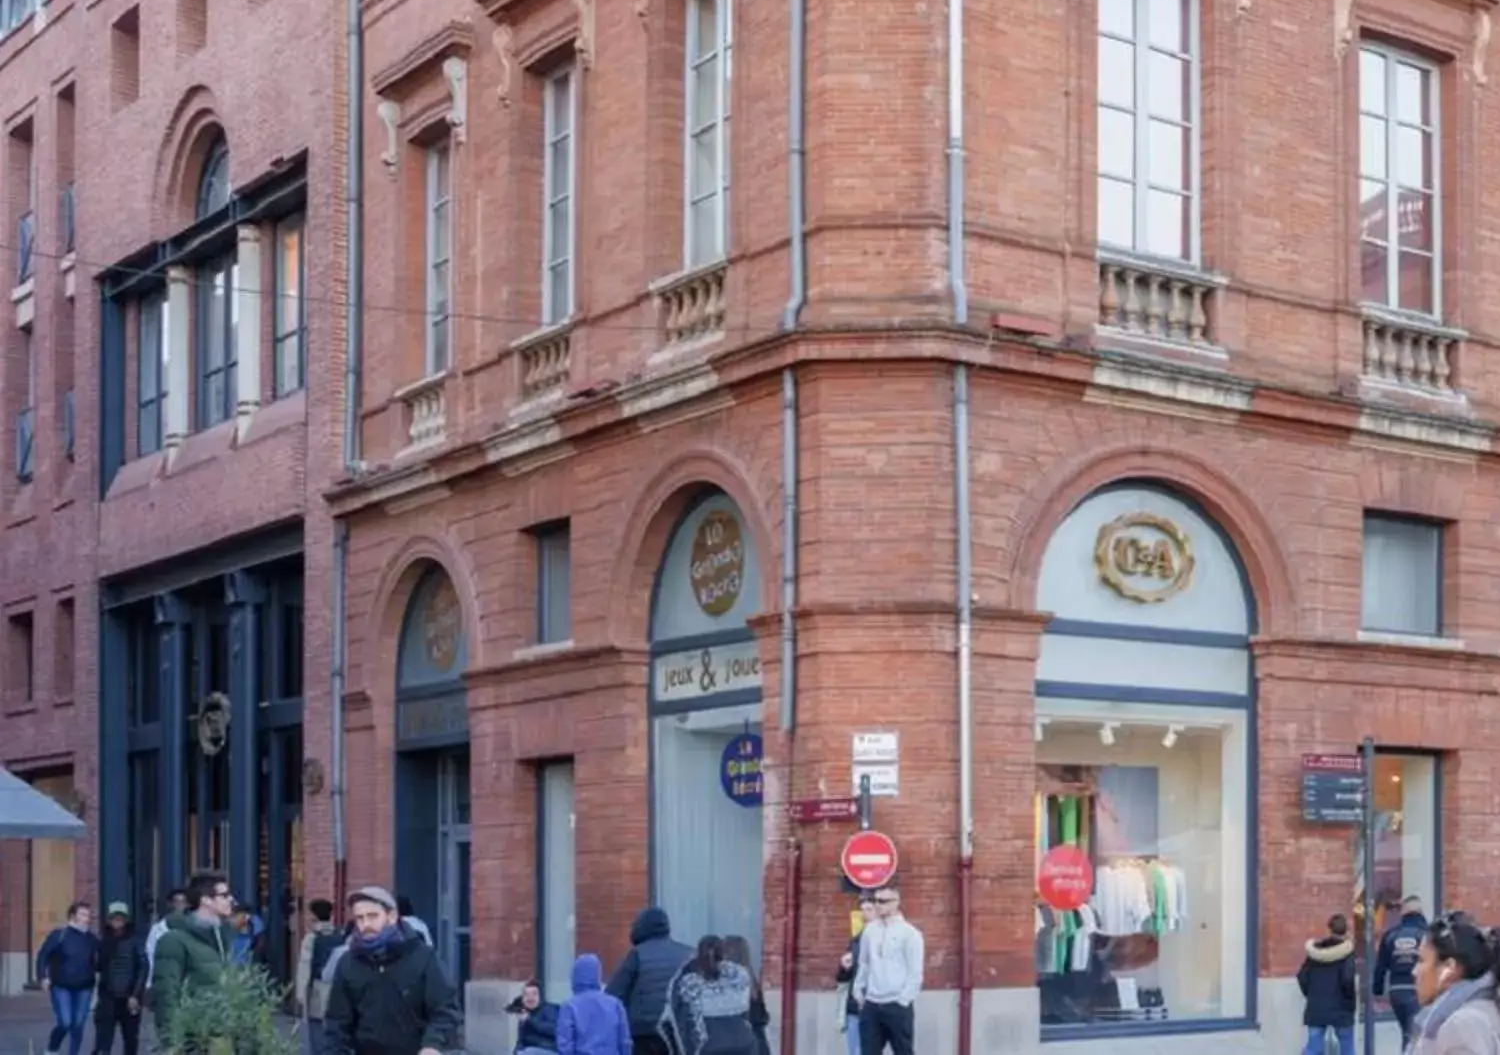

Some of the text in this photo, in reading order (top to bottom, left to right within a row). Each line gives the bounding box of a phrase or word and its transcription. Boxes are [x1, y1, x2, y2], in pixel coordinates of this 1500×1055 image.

[1113, 537, 1175, 580] C&A
[664, 664, 693, 692] jeux
[700, 648, 716, 691] &
